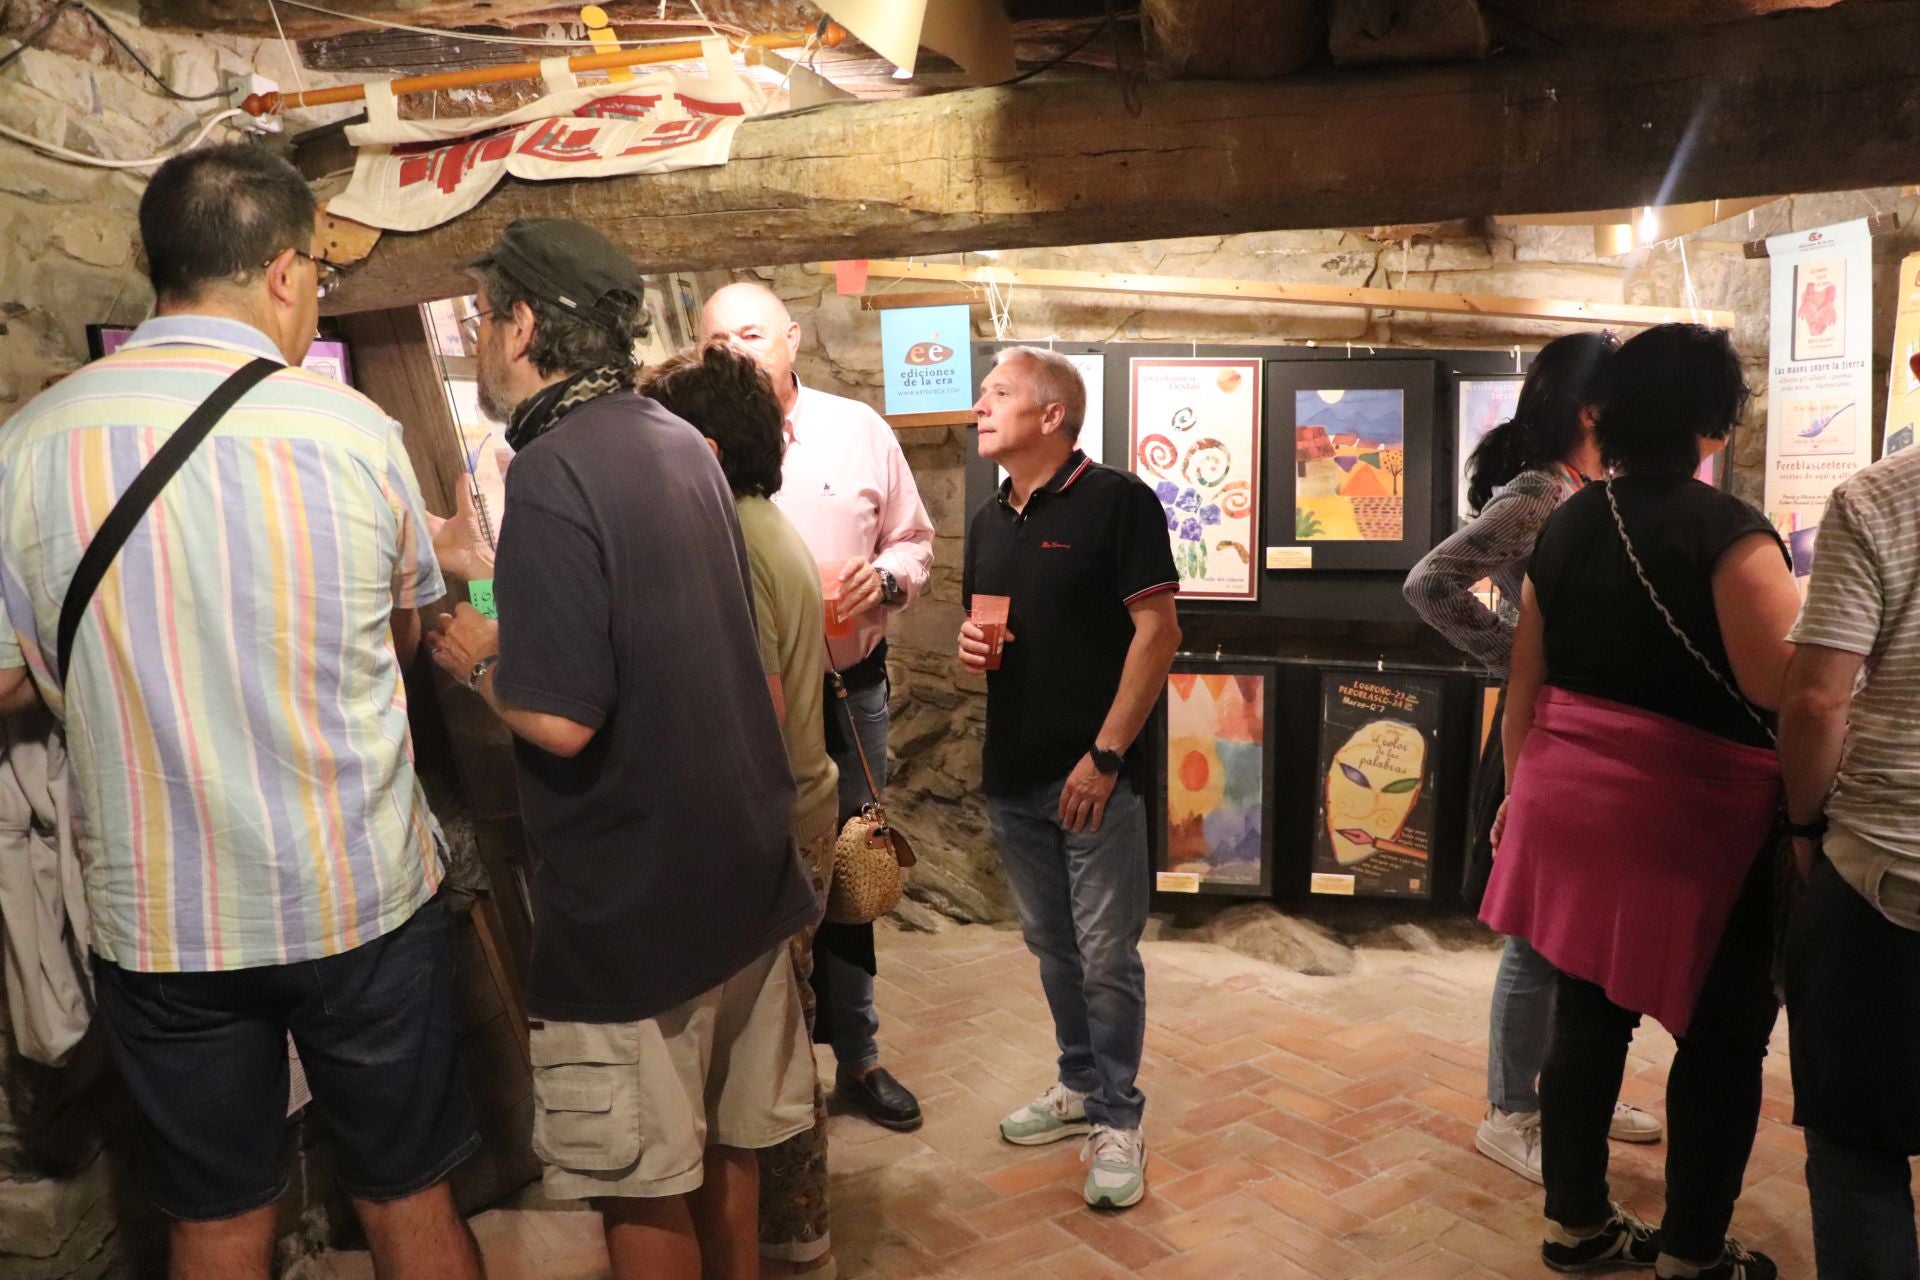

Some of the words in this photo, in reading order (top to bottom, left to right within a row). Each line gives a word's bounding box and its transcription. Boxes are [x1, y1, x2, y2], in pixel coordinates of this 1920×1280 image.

[900, 368, 956, 378] ediciones
[1787, 364, 1808, 374] manos
[1810, 363, 1830, 372] sobre
[1832, 361, 1839, 370] la
[1842, 360, 1865, 370] tierra
[903, 377, 917, 387] de
[921, 376, 931, 386] la
[935, 377, 953, 385] era
[1382, 736, 1408, 752] color
[1358, 755, 1408, 775] palabras
